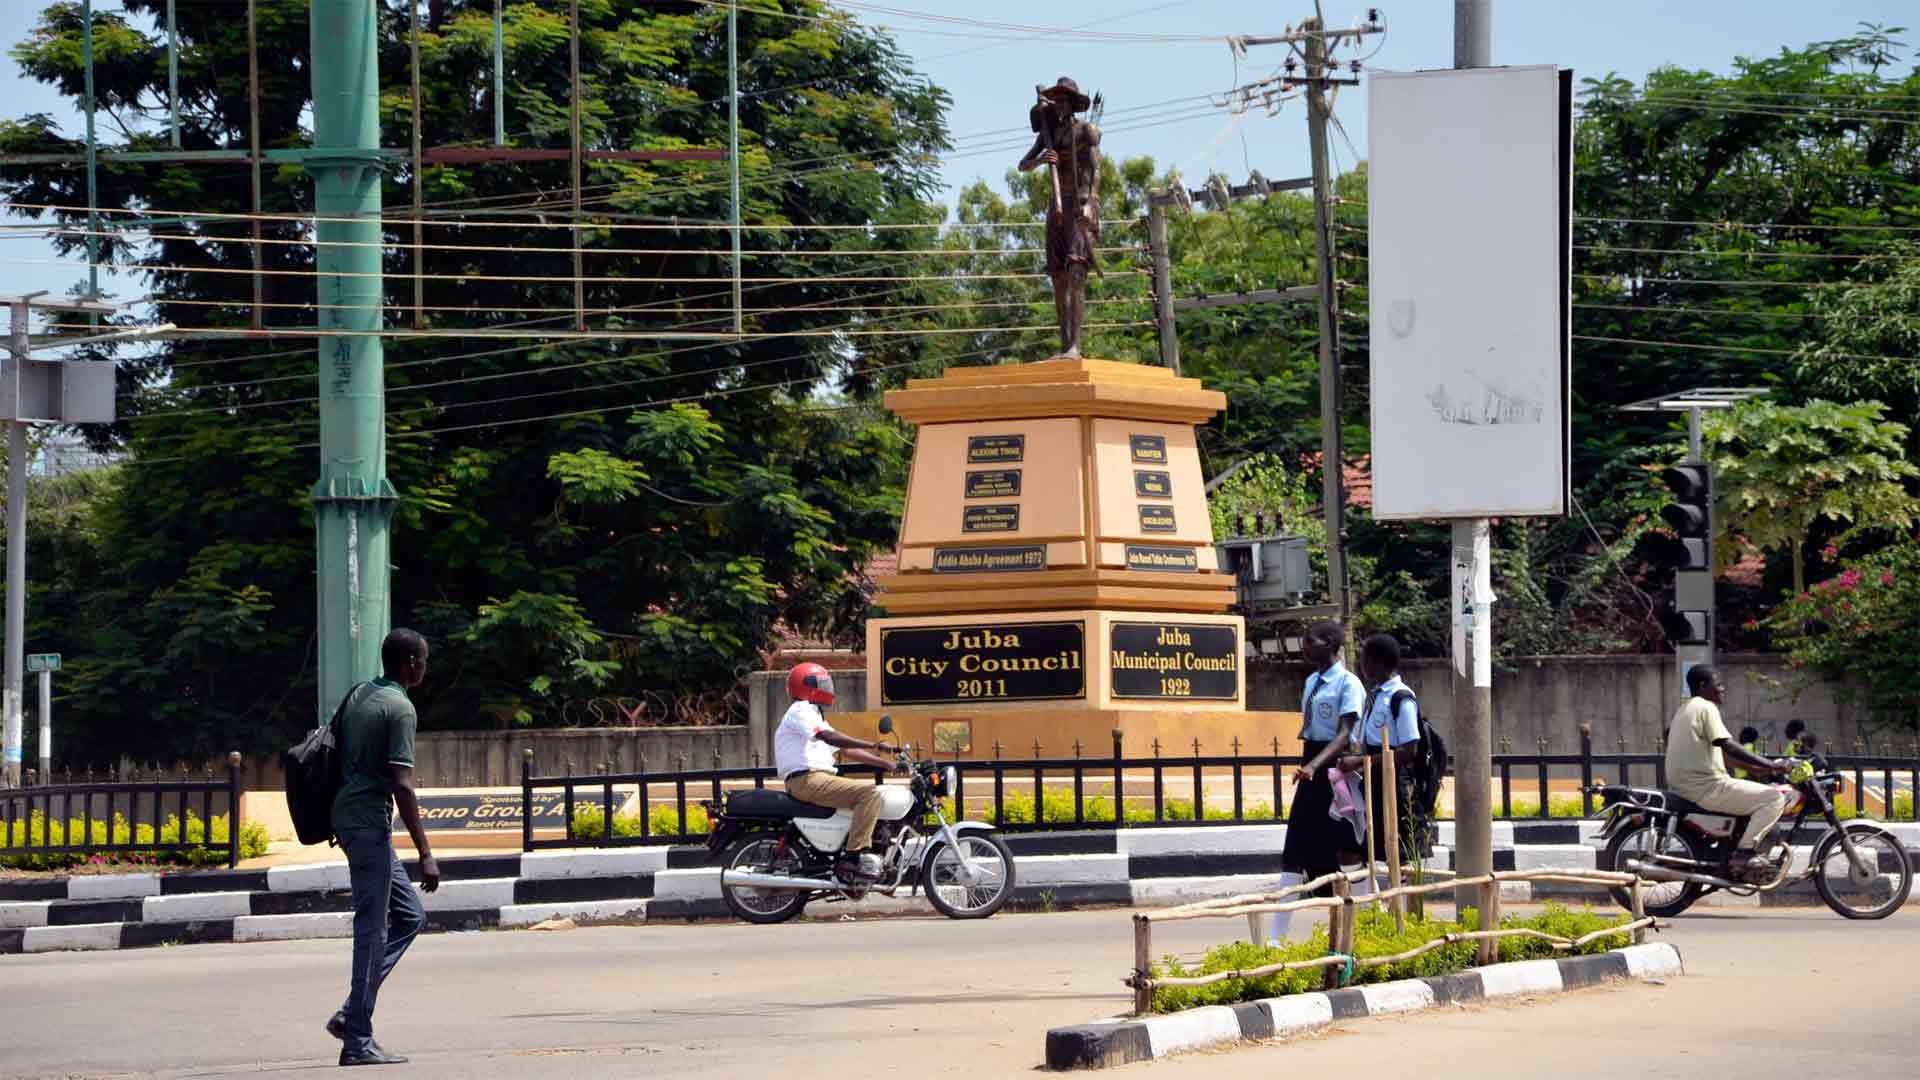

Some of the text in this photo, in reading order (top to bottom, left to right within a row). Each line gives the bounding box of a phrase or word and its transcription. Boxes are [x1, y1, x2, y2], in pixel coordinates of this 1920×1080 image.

[983, 553, 1023, 568] Agreement
[943, 631, 1020, 650] Juba
[1157, 627, 1190, 647] Juba
[885, 651, 1080, 679] City Council
[1112, 652, 1236, 673] Municipal Council
[957, 679, 1007, 698] 2011
[1160, 679, 1190, 696] 1922
[417, 805, 469, 819] ecno
